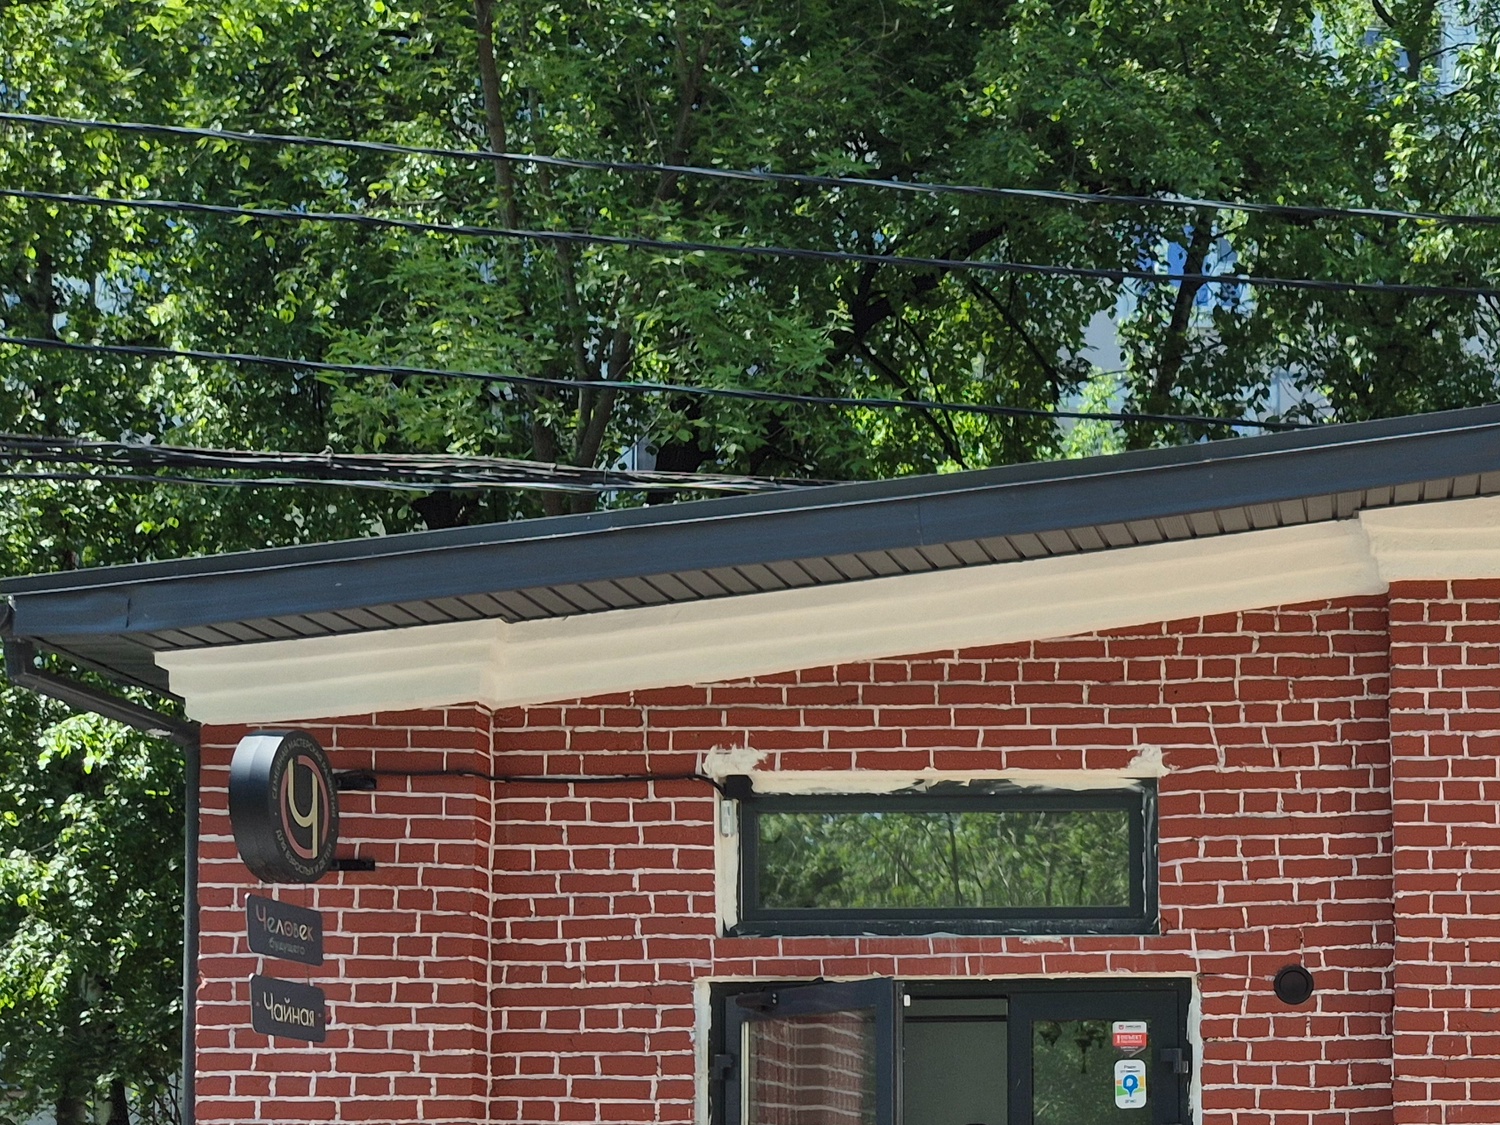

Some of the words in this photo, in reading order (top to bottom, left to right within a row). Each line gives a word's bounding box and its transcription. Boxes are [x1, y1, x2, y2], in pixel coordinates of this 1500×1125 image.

[255, 904, 314, 942] Человек
[269, 937, 306, 956] будущего
[263, 991, 315, 1027] Чайная
